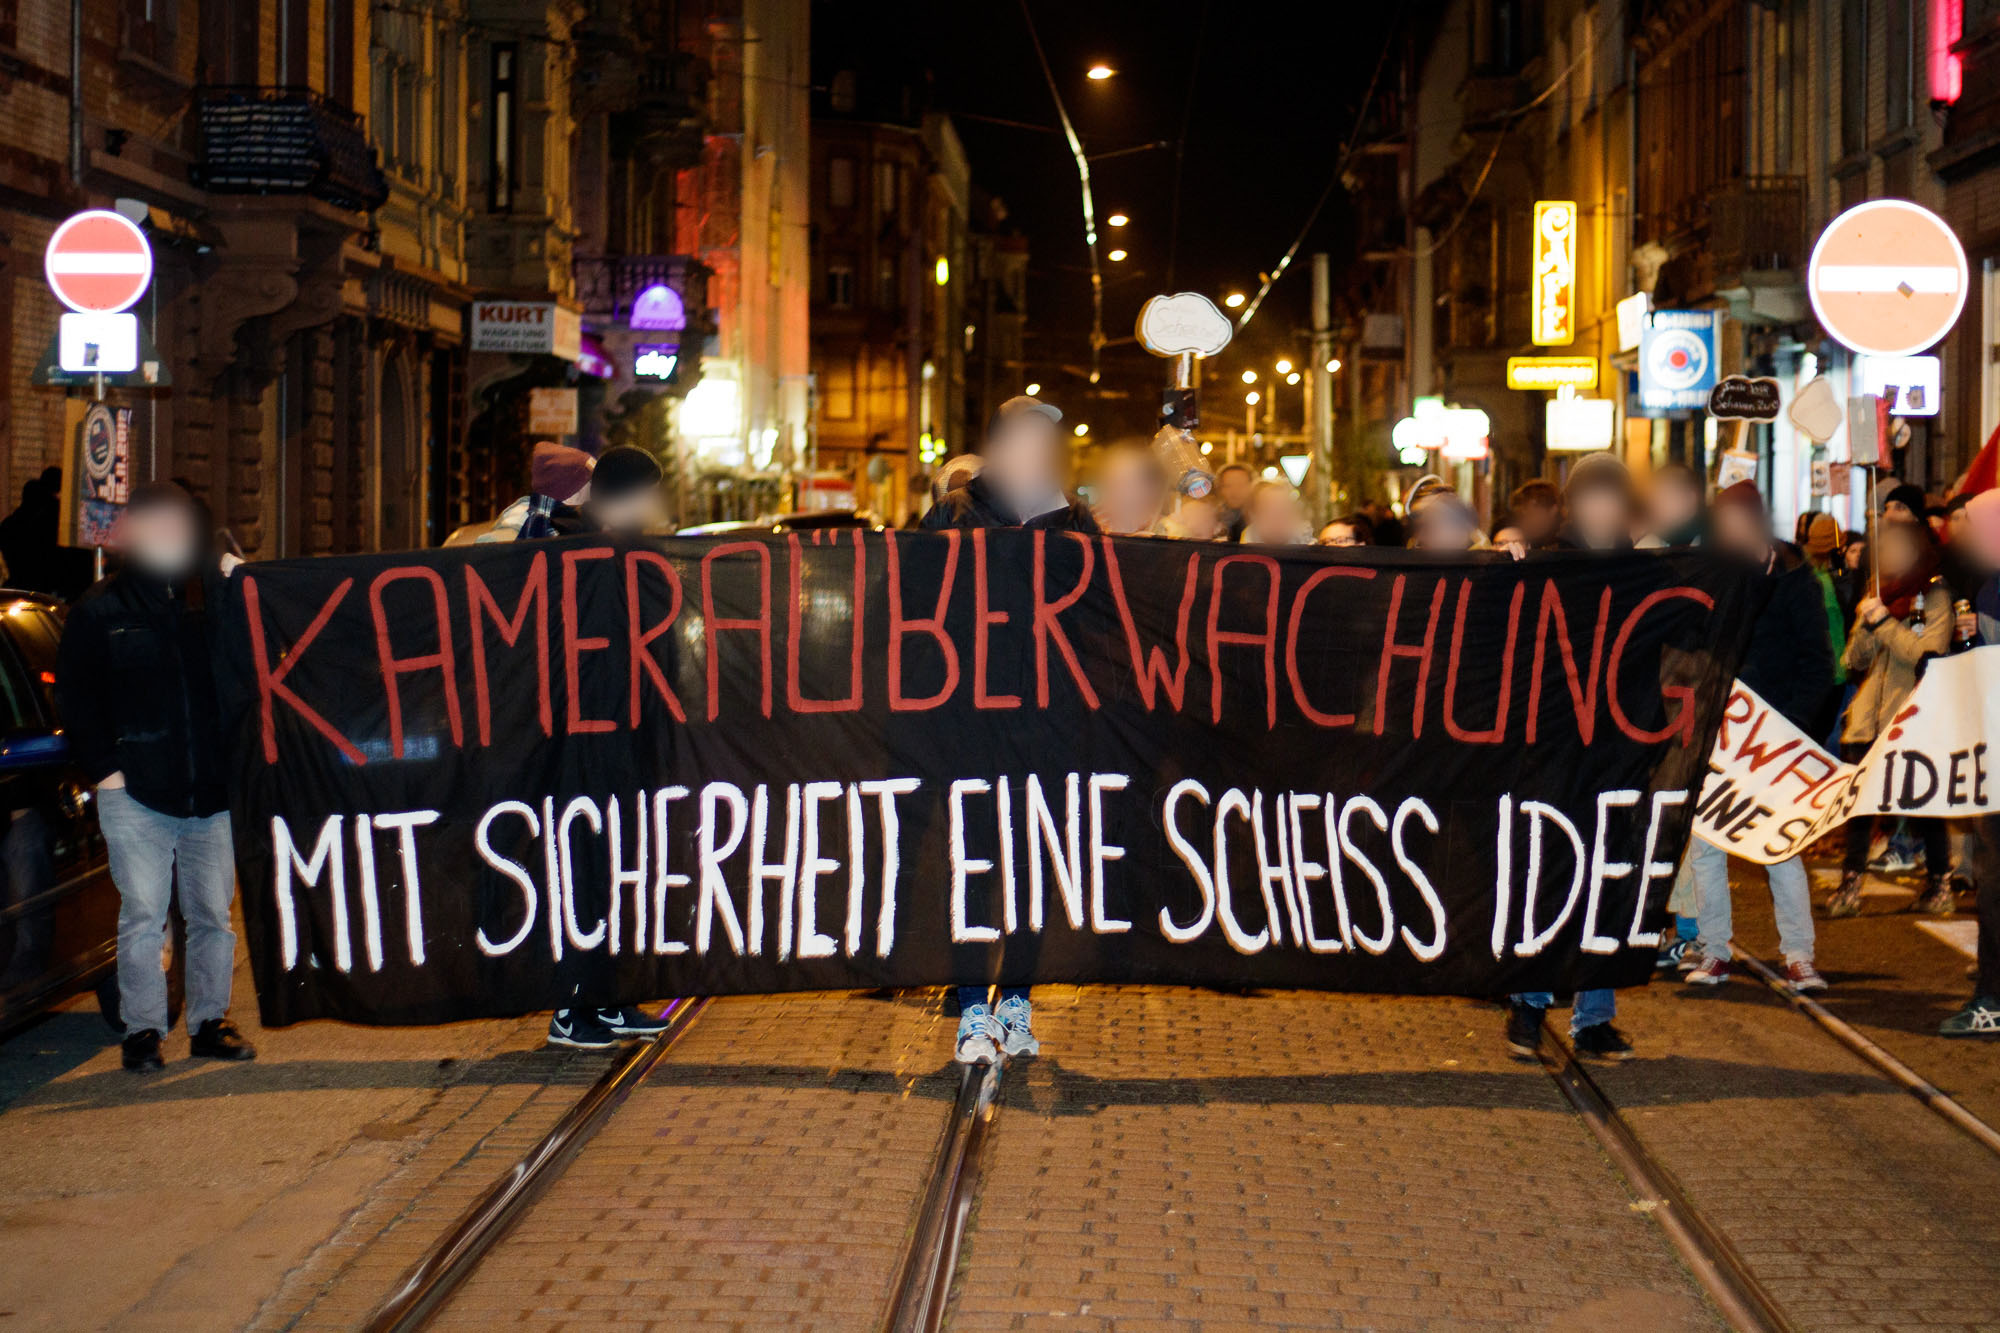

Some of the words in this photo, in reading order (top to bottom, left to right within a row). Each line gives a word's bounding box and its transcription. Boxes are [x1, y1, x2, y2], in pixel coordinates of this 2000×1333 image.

[479, 306, 548, 324] KURT
[243, 527, 1714, 766] KAMERAÜBERWACHUNG
[1878, 743, 1988, 812] IDEE
[272, 808, 440, 974] MIT
[475, 776, 923, 964] SICHERHEIT
[949, 772, 1133, 943] EINE
[1158, 778, 1447, 963] SCHEISS
[1491, 788, 1689, 959] IDEE
